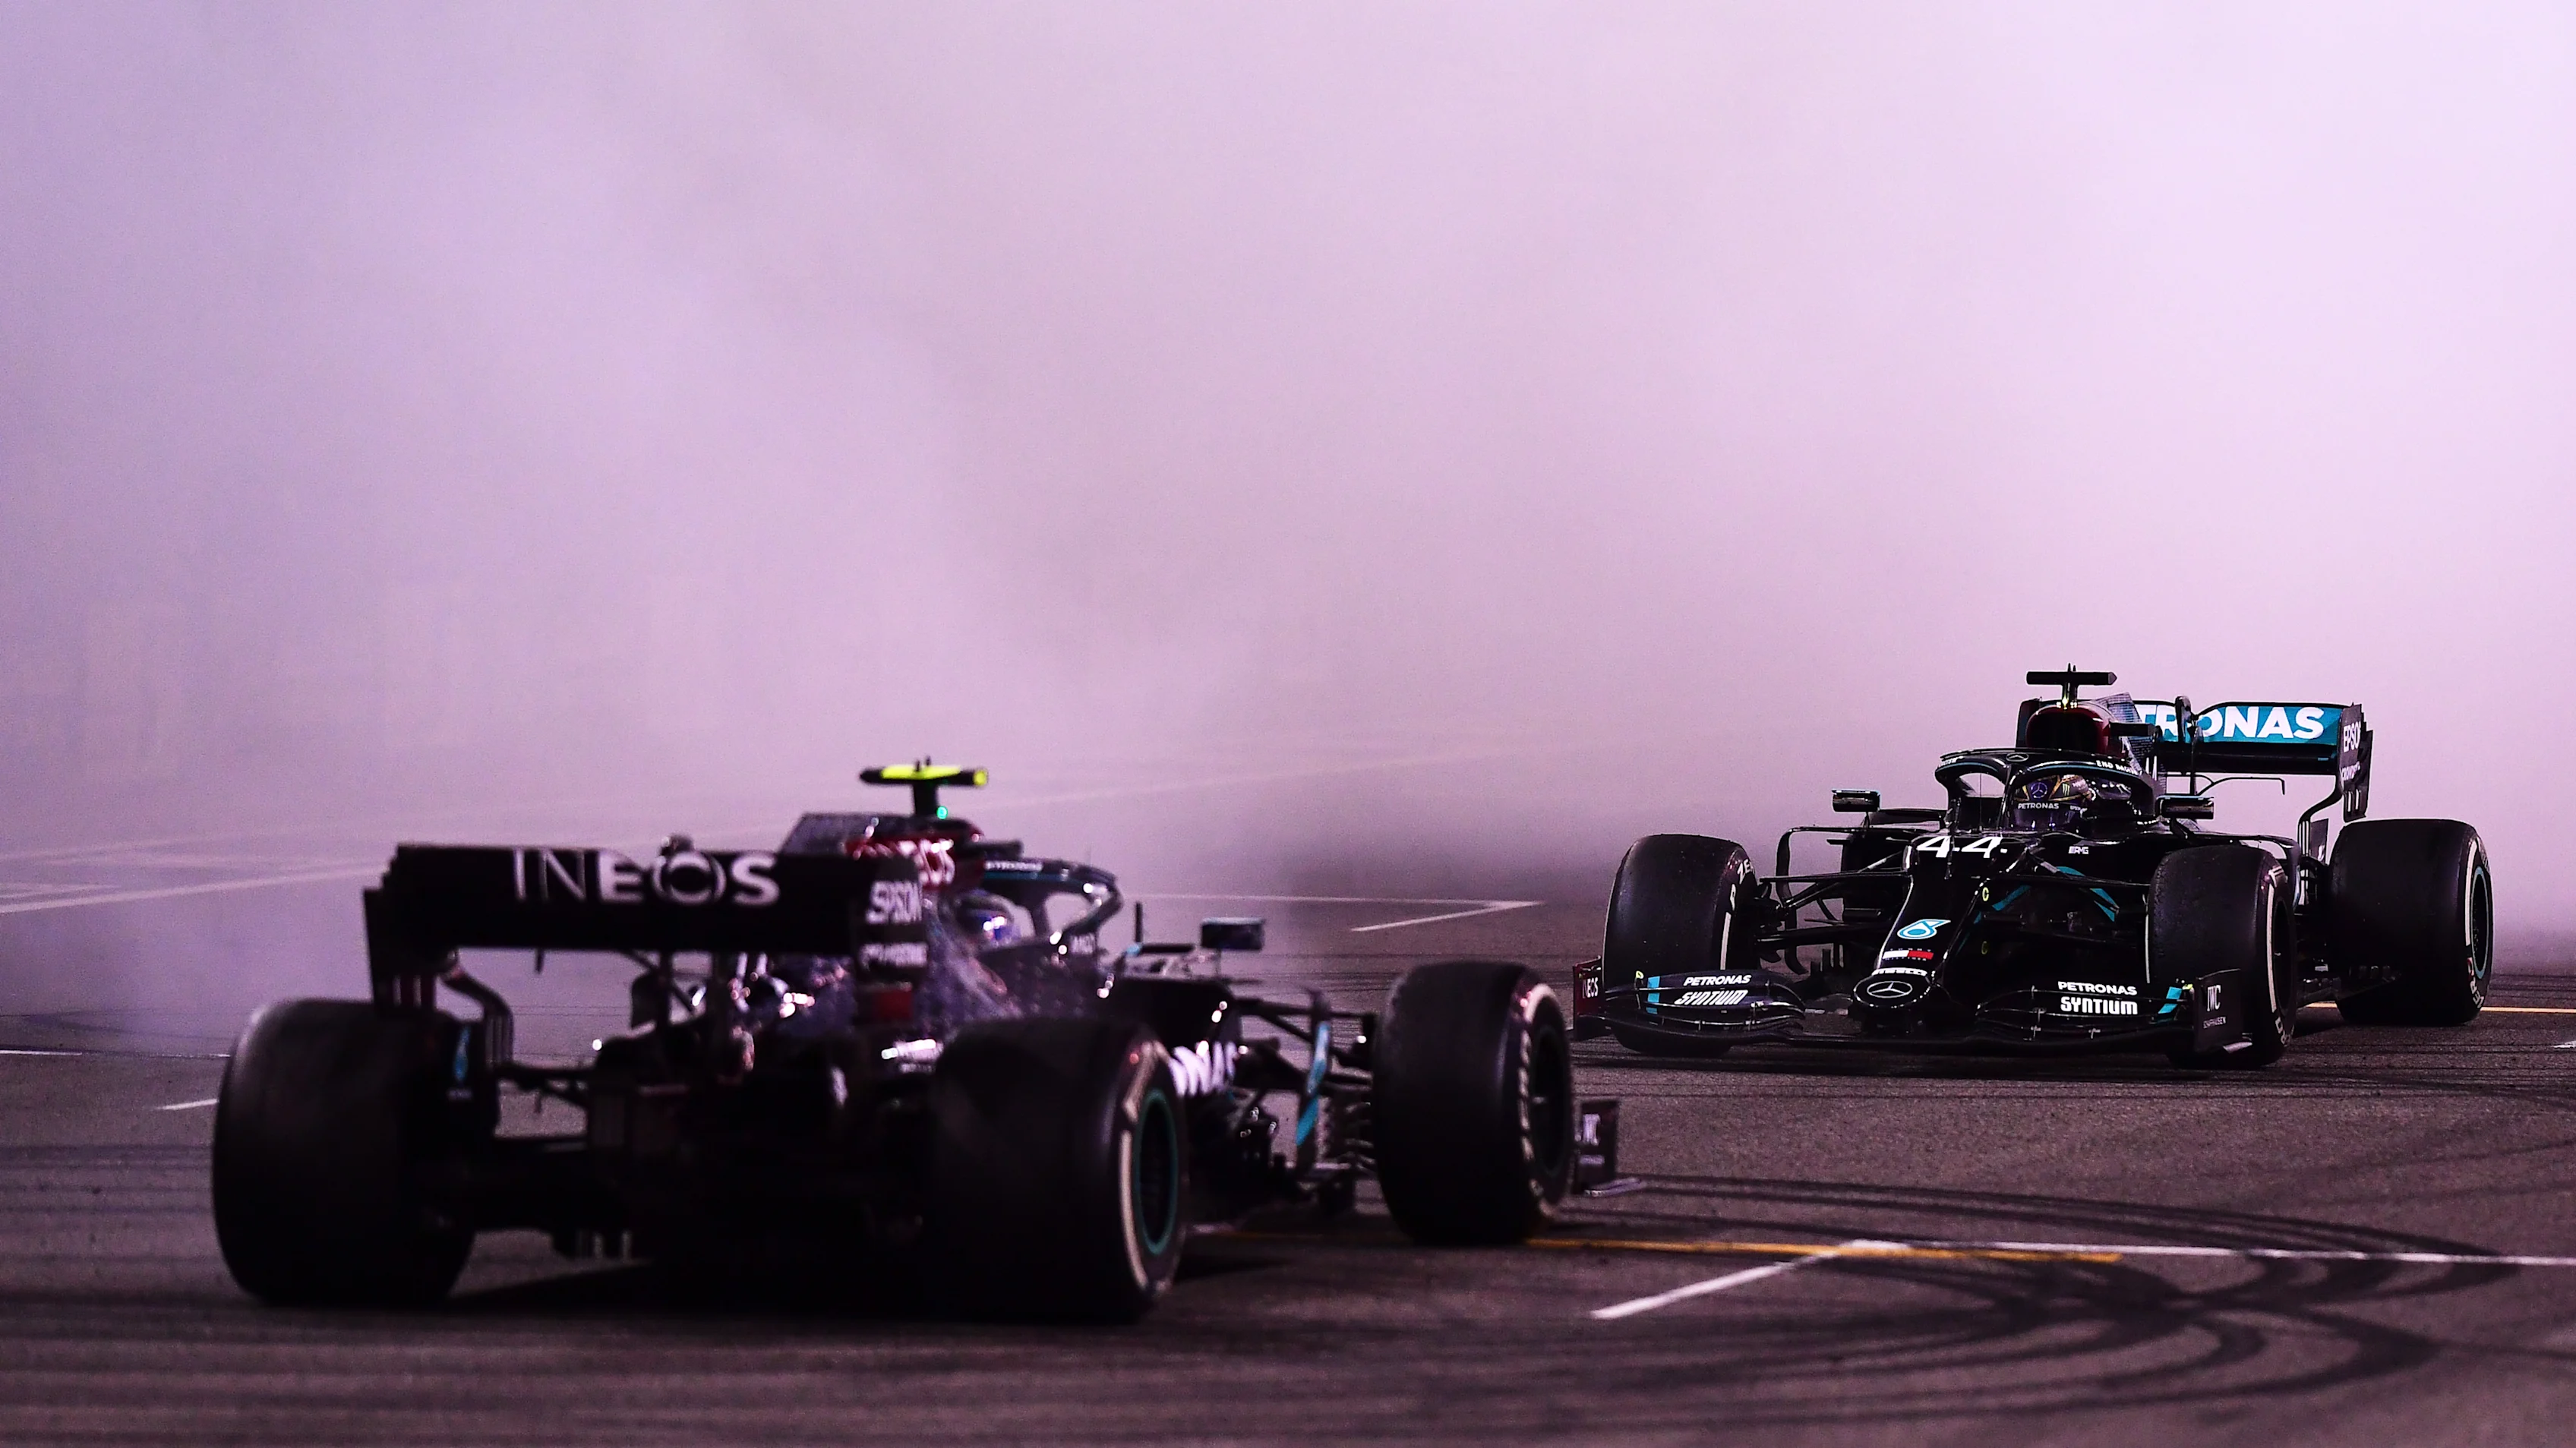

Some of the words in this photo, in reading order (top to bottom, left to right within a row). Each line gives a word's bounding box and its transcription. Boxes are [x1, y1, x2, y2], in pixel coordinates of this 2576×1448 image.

[2343, 721, 2361, 752] EPSO
[1916, 836, 2007, 858] 44
[513, 848, 781, 905] INEOS
[1683, 974, 1752, 986] PETRONAS
[2057, 981, 2138, 995] PETRONAS
[1674, 989, 1748, 1006] SYNTIUM
[2060, 995, 2138, 1014] SYNTIUM
